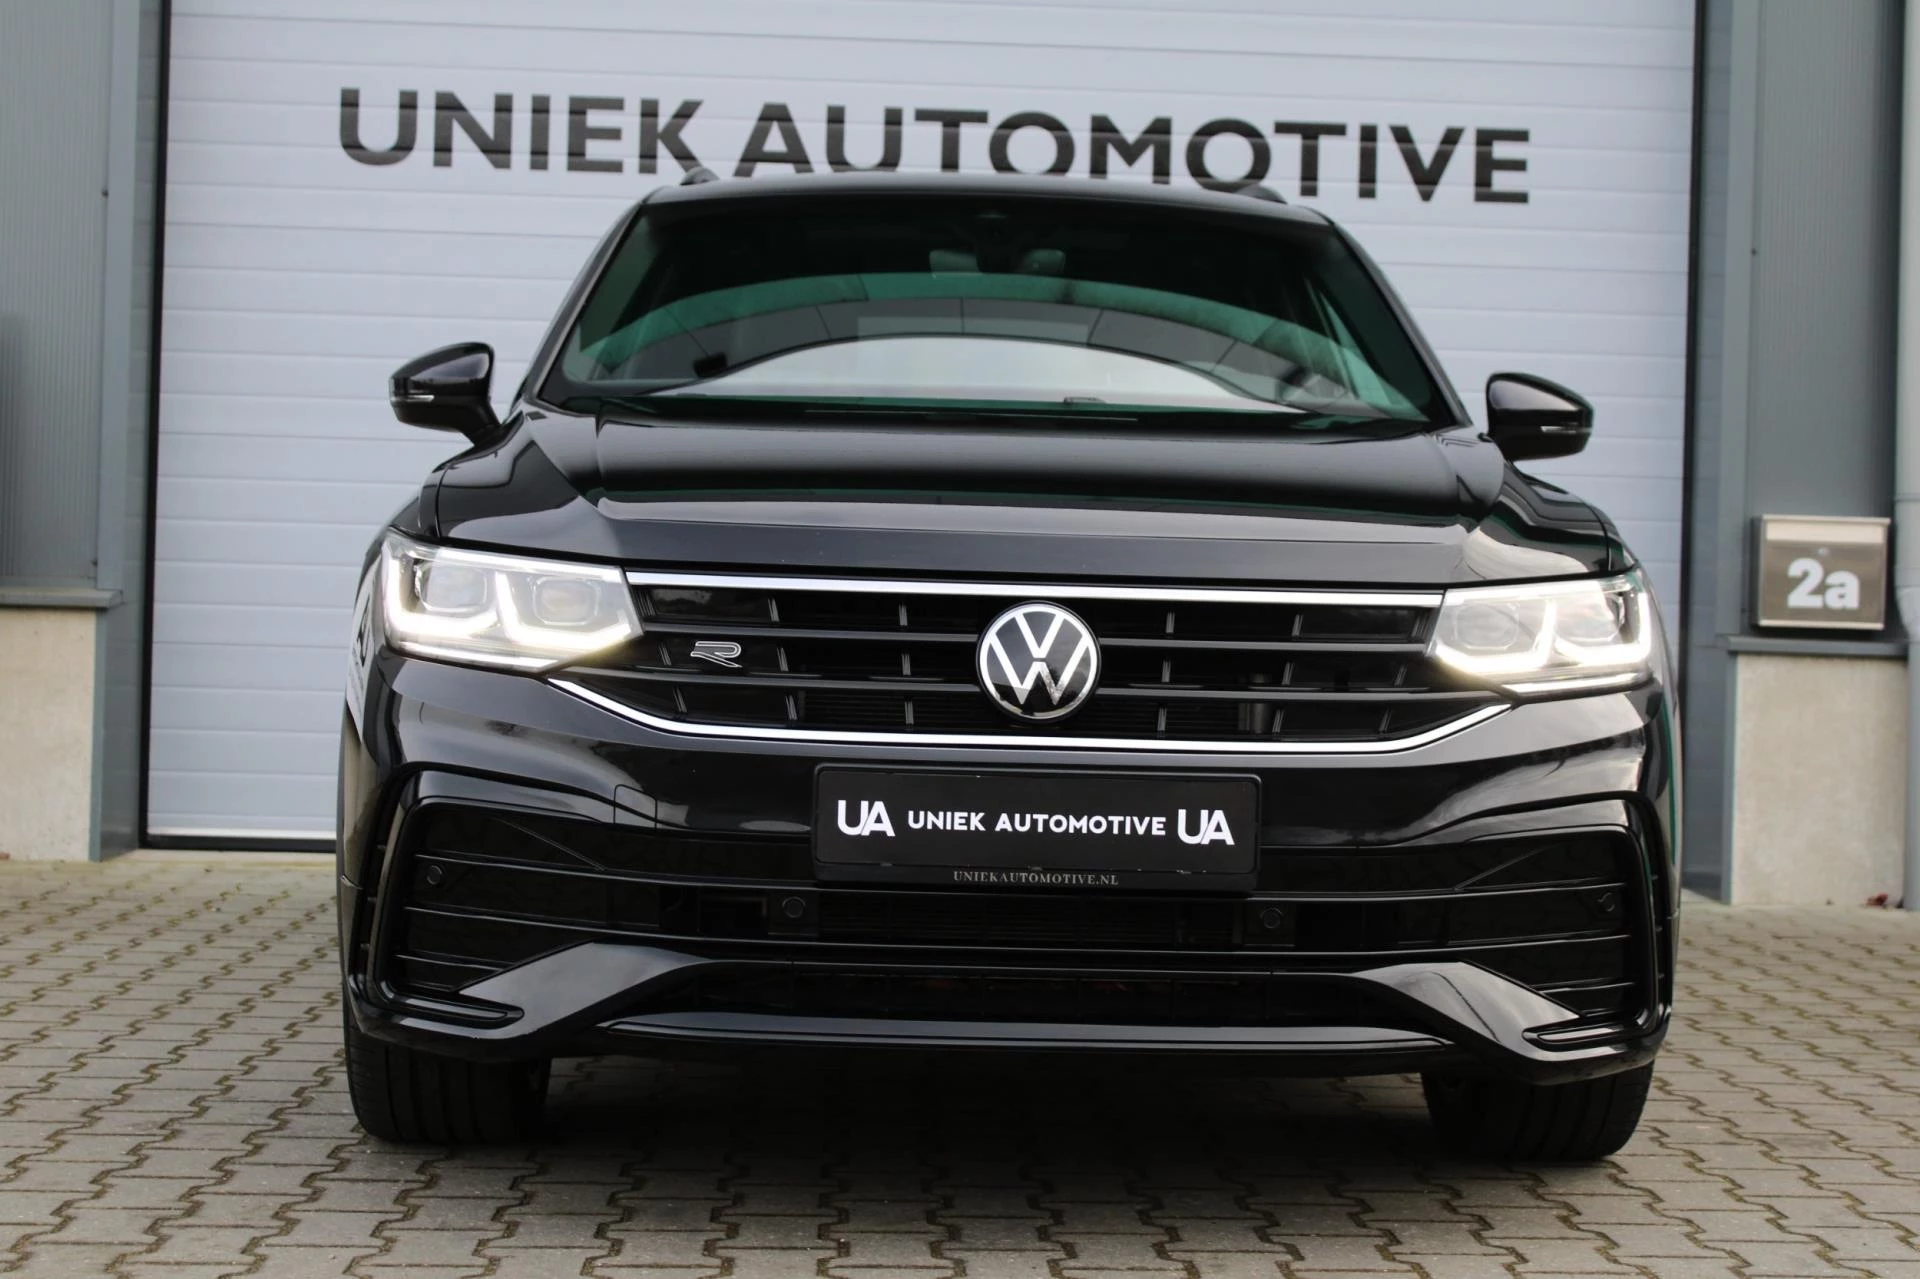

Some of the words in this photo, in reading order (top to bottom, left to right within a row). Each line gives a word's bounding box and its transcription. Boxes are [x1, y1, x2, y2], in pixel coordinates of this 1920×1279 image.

[340, 87, 704, 175] UNIEK
[732, 102, 1530, 204] AUTOMOTIVE
[1787, 557, 1860, 609] 2a
[690, 641, 742, 668] R
[837, 800, 895, 837] UA
[907, 810, 986, 832] UNIEK
[995, 813, 1166, 836] AUTOMOTIVE
[1177, 808, 1235, 846] UA
[953, 871, 1119, 886] UNIEKAUTOMOTIVE.NL
